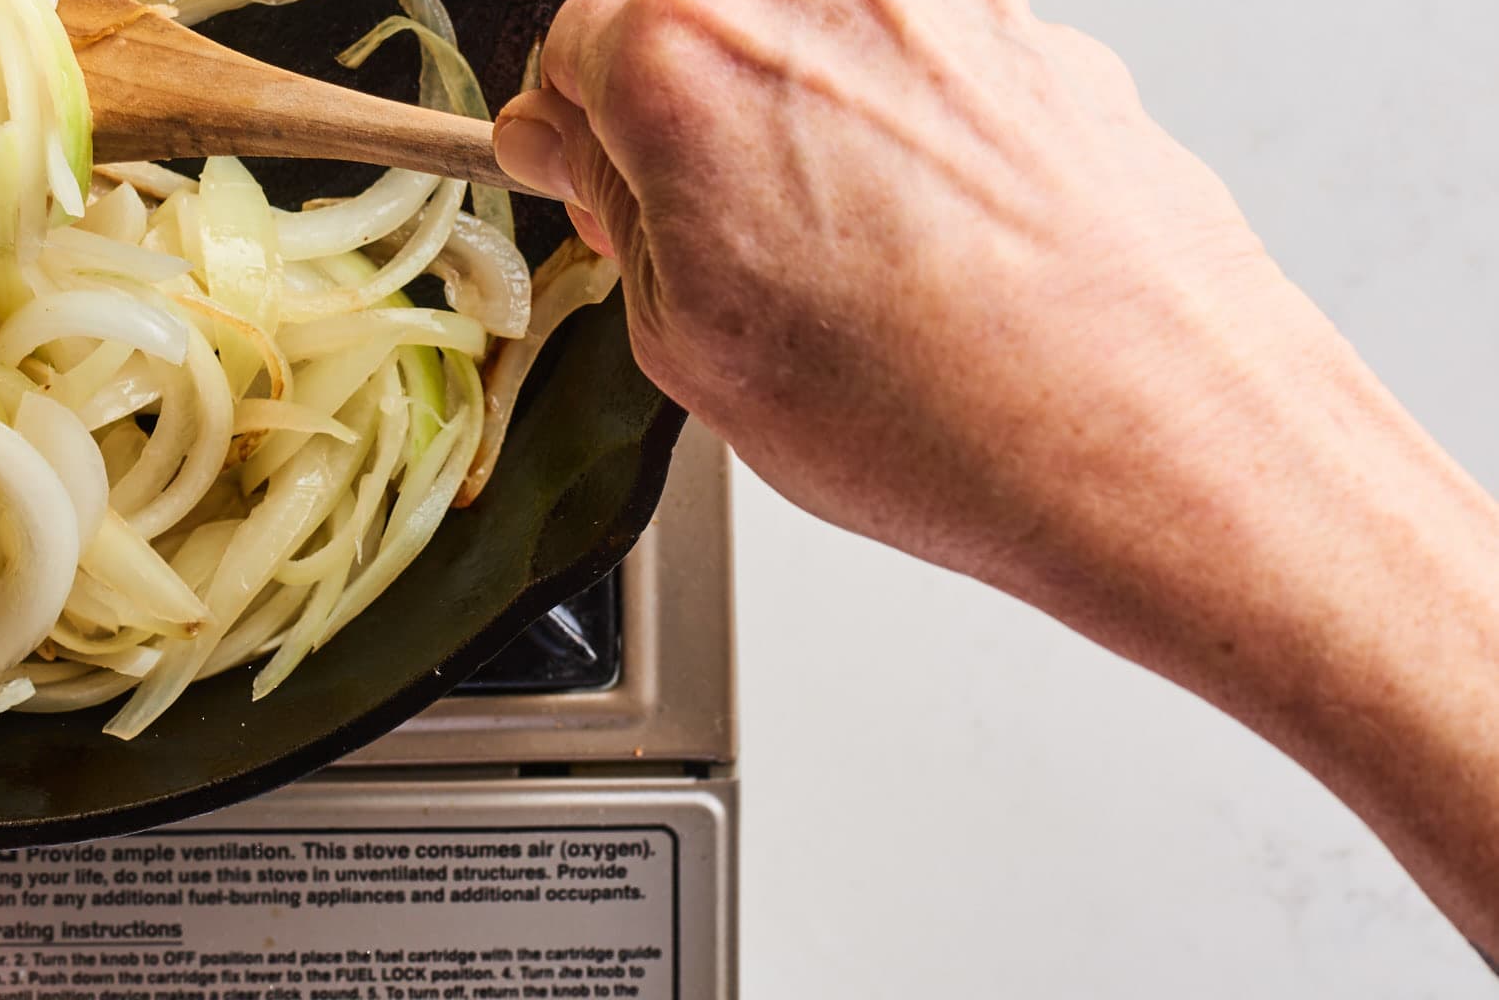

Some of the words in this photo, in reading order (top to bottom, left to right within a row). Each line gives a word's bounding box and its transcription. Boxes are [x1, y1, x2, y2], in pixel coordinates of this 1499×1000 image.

[26, 844, 106, 862] Provide
[112, 844, 176, 865] ample
[180, 842, 296, 861] ventilation.
[302, 841, 347, 860] This
[352, 842, 411, 860] stove
[415, 843, 522, 859] consumes
[527, 840, 555, 858] air
[560, 839, 656, 863] (oxygen).
[27, 872, 70, 887] your
[74, 868, 108, 886] life,
[113, 868, 138, 885] do
[142, 868, 174, 884] not
[178, 870, 212, 884] use
[216, 867, 252, 884] this
[256, 867, 308, 883] stove
[312, 866, 330, 883] in
[334, 865, 448, 882] unventilated
[452, 865, 552, 882] structures.
[557, 863, 628, 880] Provide
[21, 890, 48, 907] for
[52, 893, 87, 907] any
[91, 888, 183, 906] additional
[188, 888, 302, 906] fuel-burning
[306, 887, 406, 905] appliances
[410, 886, 445, 904] and
[449, 886, 540, 903] additional
[545, 885, 646, 903] occupants.
[61, 920, 183, 939] instructions
[14, 953, 28, 967] 2.
[32, 952, 68, 966] Turn
[70, 952, 97, 967] the
[100, 952, 140, 966] knob
[143, 952, 160, 966] to
[162, 950, 196, 966] OFF
[200, 951, 264, 966] position
[267, 950, 297, 965] and
[300, 950, 344, 965] place
[346, 950, 372, 964] the
[374, 949, 404, 964] fuel
[407, 948, 477, 964] cartridge
[480, 948, 513, 962] with
[516, 948, 542, 962] the
[545, 947, 615, 963] cartridge
[618, 946, 662, 962] guide
[10, 971, 23, 986] 3.
[28, 971, 68, 986] Push
[71, 971, 115, 986] down
[118, 971, 144, 985] the
[146, 970, 218, 985] cartridge
[220, 969, 241, 984] fix
[244, 969, 283, 984] lever
[286, 969, 303, 983] to
[306, 968, 332, 983] the
[335, 968, 377, 983] FUEL
[381, 967, 427, 982] LOCK
[430, 967, 497, 983] position.
[501, 966, 515, 980] 4.
[519, 966, 555, 980] Turn
[558, 966, 584, 980] the
[586, 965, 626, 979] knob
[628, 965, 645, 979] to
[310, 987, 363, 1000] sound.
[367, 986, 381, 1000] 5.
[385, 985, 405, 1000] To
[407, 987, 440, 1000] turn
[443, 985, 469, 1000] off,
[472, 986, 520, 999] return
[522, 985, 549, 999] the
[551, 984, 591, 998] knob
[594, 984, 610, 998] to
[613, 983, 639, 997] the
